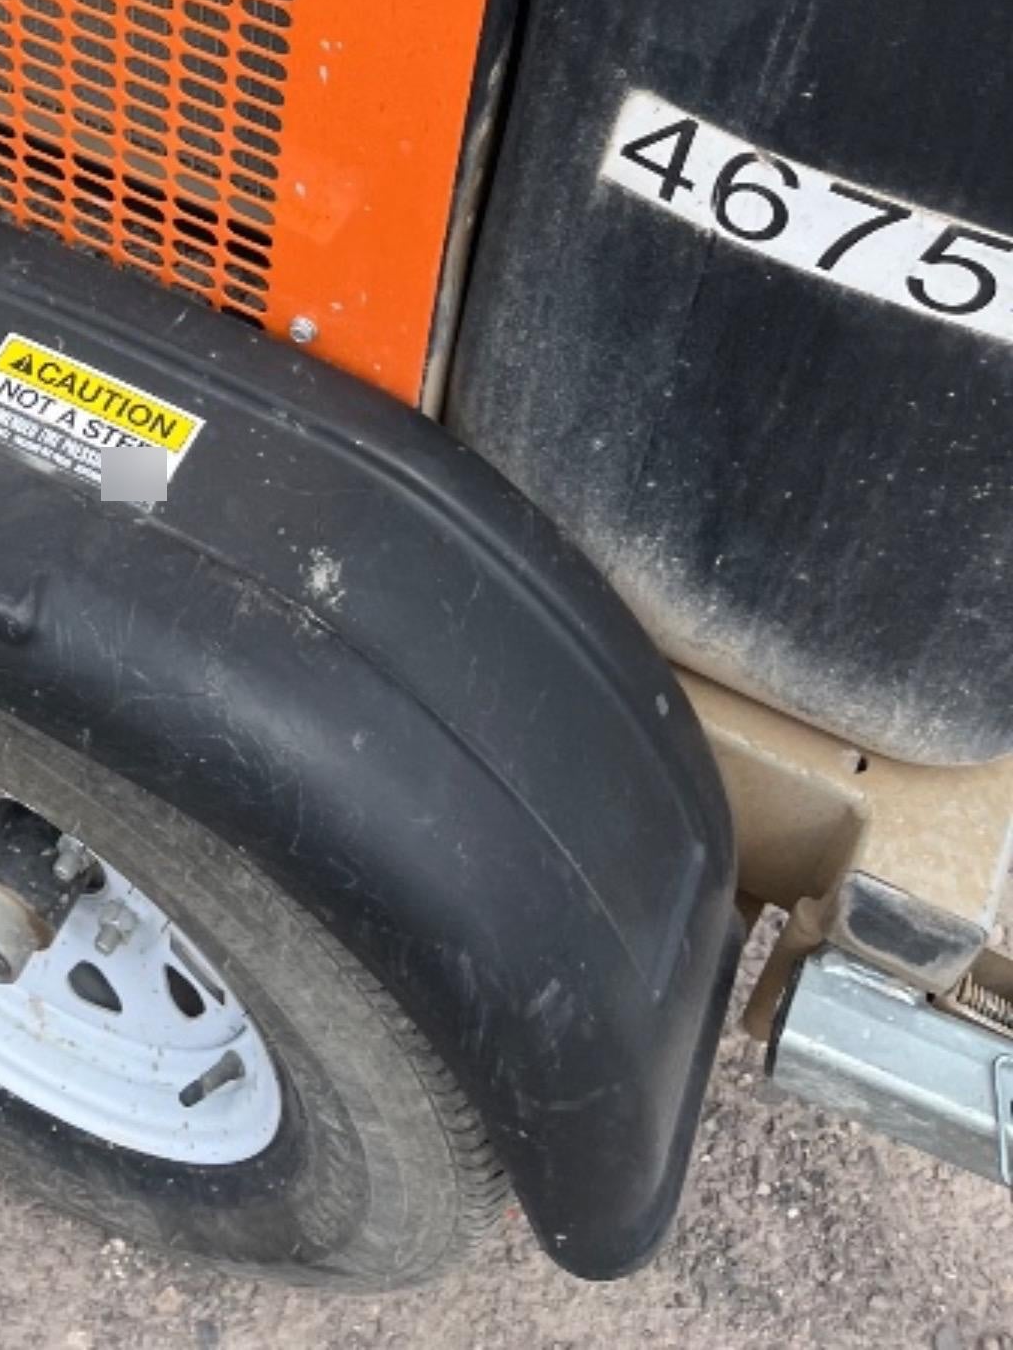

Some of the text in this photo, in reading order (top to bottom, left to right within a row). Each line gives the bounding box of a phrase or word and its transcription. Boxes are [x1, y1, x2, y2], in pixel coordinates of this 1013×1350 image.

[619, 116, 1013, 315] 4675
[37, 361, 178, 439] CAUTION
[55, 409, 77, 430] A
[83, 418, 156, 448] STE
